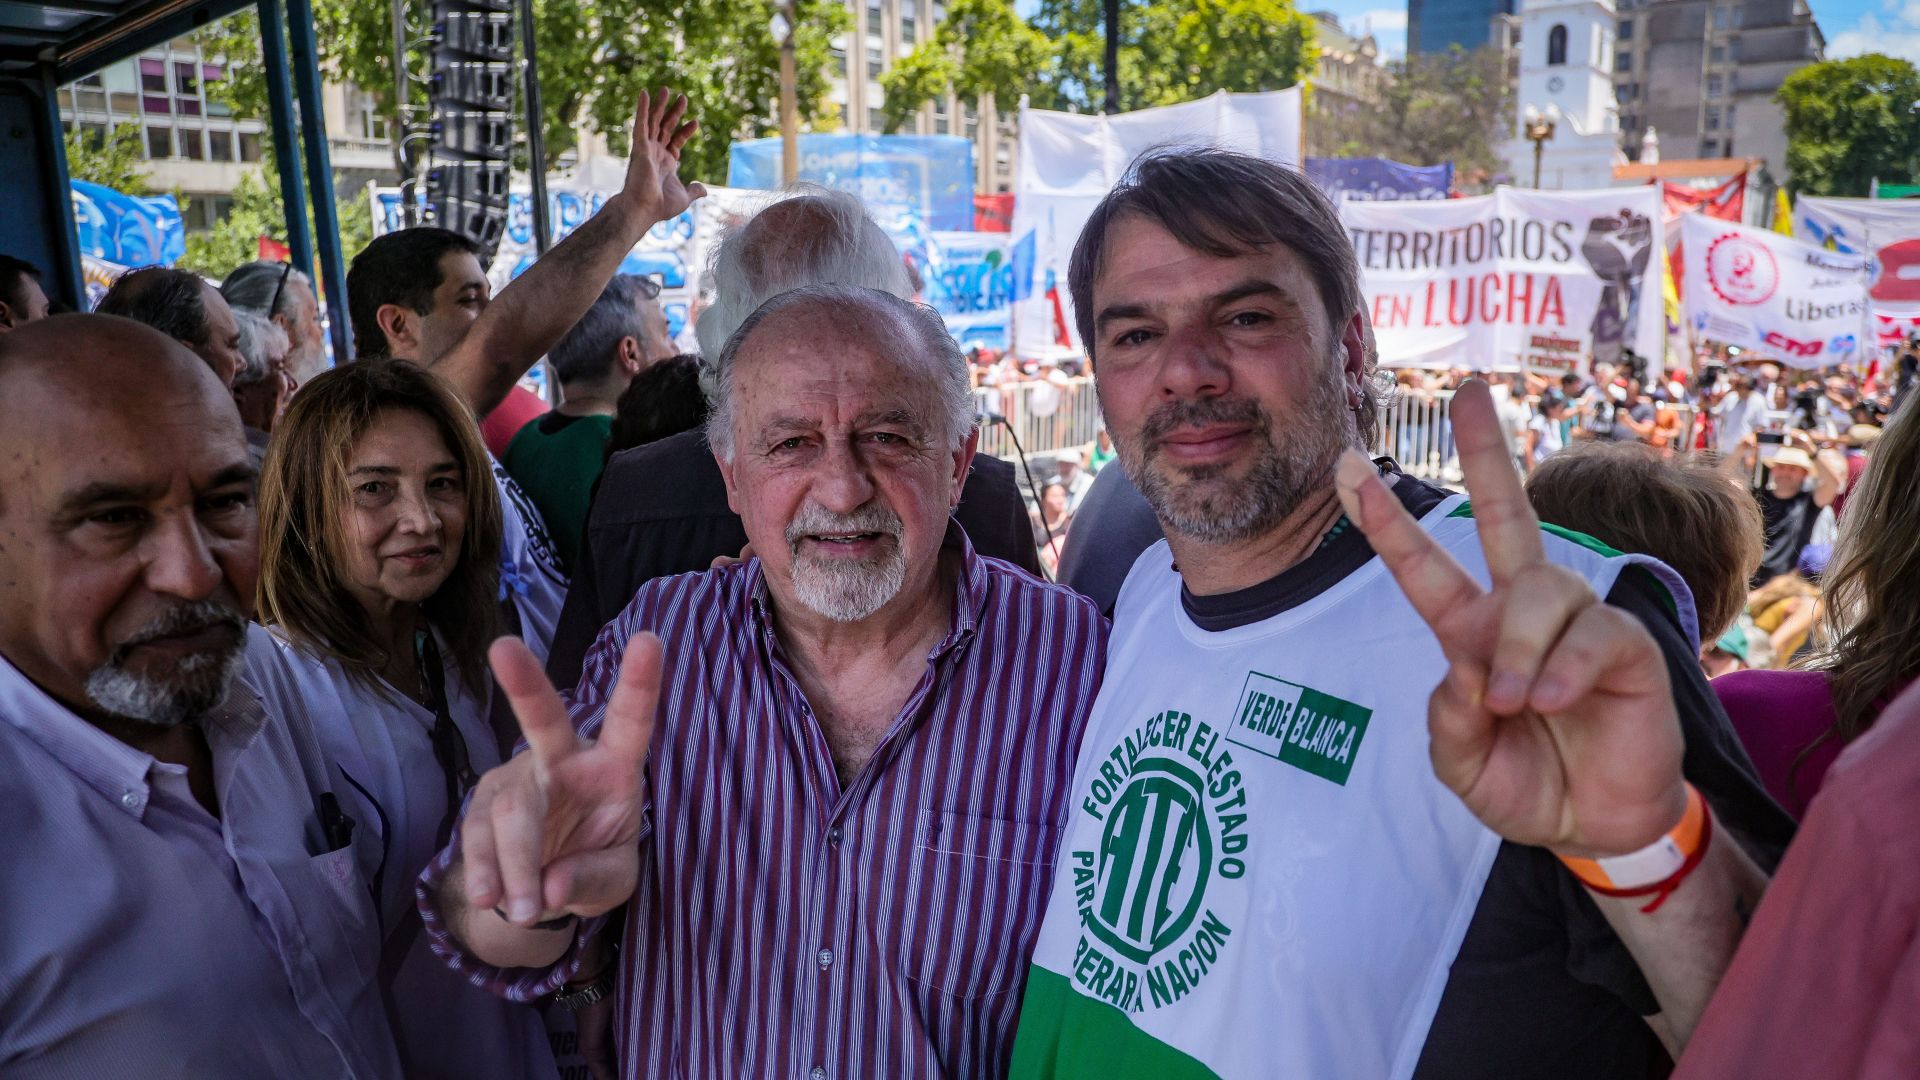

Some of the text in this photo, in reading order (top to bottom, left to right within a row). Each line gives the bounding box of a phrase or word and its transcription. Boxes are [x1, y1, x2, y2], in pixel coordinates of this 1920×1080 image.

[1350, 217, 1573, 270] TERRITORIOS
[1372, 271, 1566, 328] EN LUCHA
[1083, 710, 1191, 821] FORTALECER
[1240, 690, 1357, 765] VERDE BLANCA
[1100, 777, 1198, 946] ATE
[1072, 851, 1095, 928] PARA
[1146, 908, 1232, 1009] NACION
